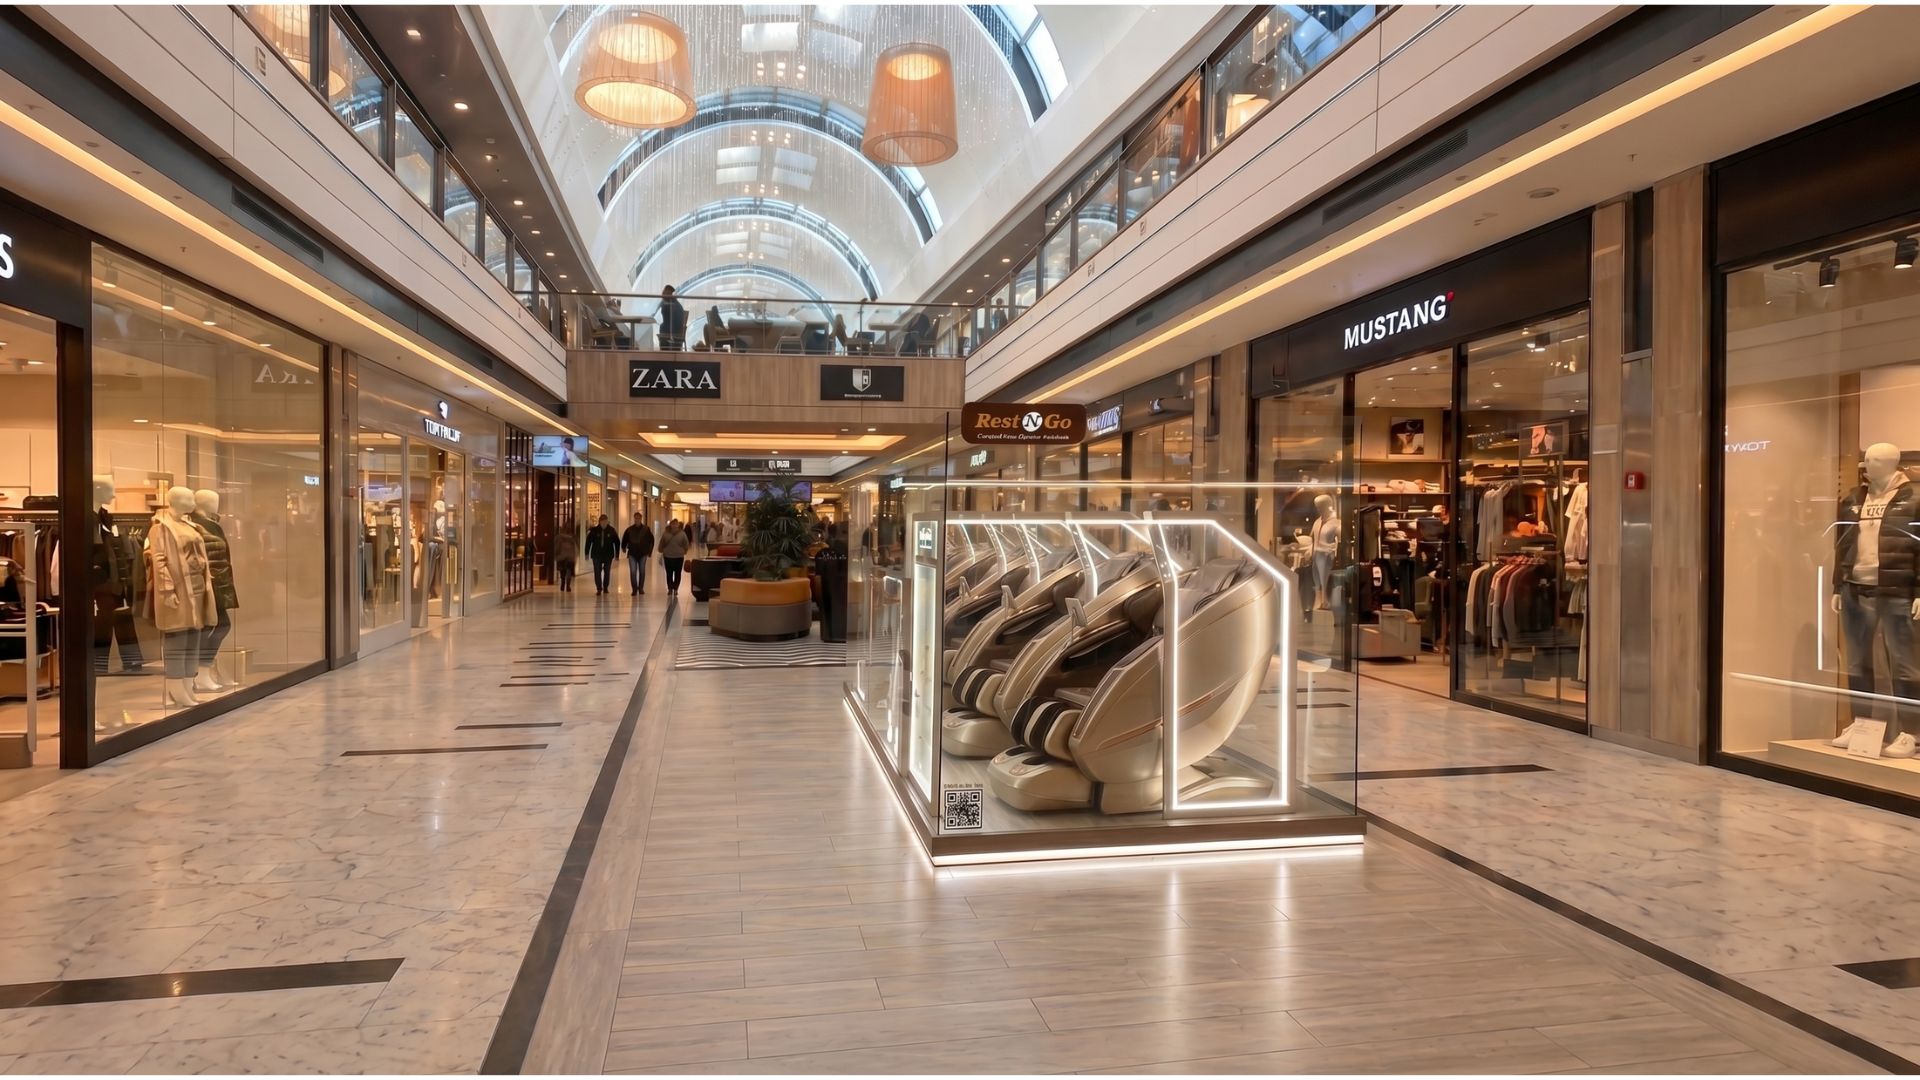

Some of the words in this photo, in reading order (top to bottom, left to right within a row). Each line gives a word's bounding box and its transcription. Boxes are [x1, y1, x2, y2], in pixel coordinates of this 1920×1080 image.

[1344, 294, 1448, 350] MUSTANG
[632, 368, 717, 390] ZARA
[975, 413, 1022, 429] Rest
[1024, 414, 1043, 428] N
[1044, 413, 1072, 429] Go
